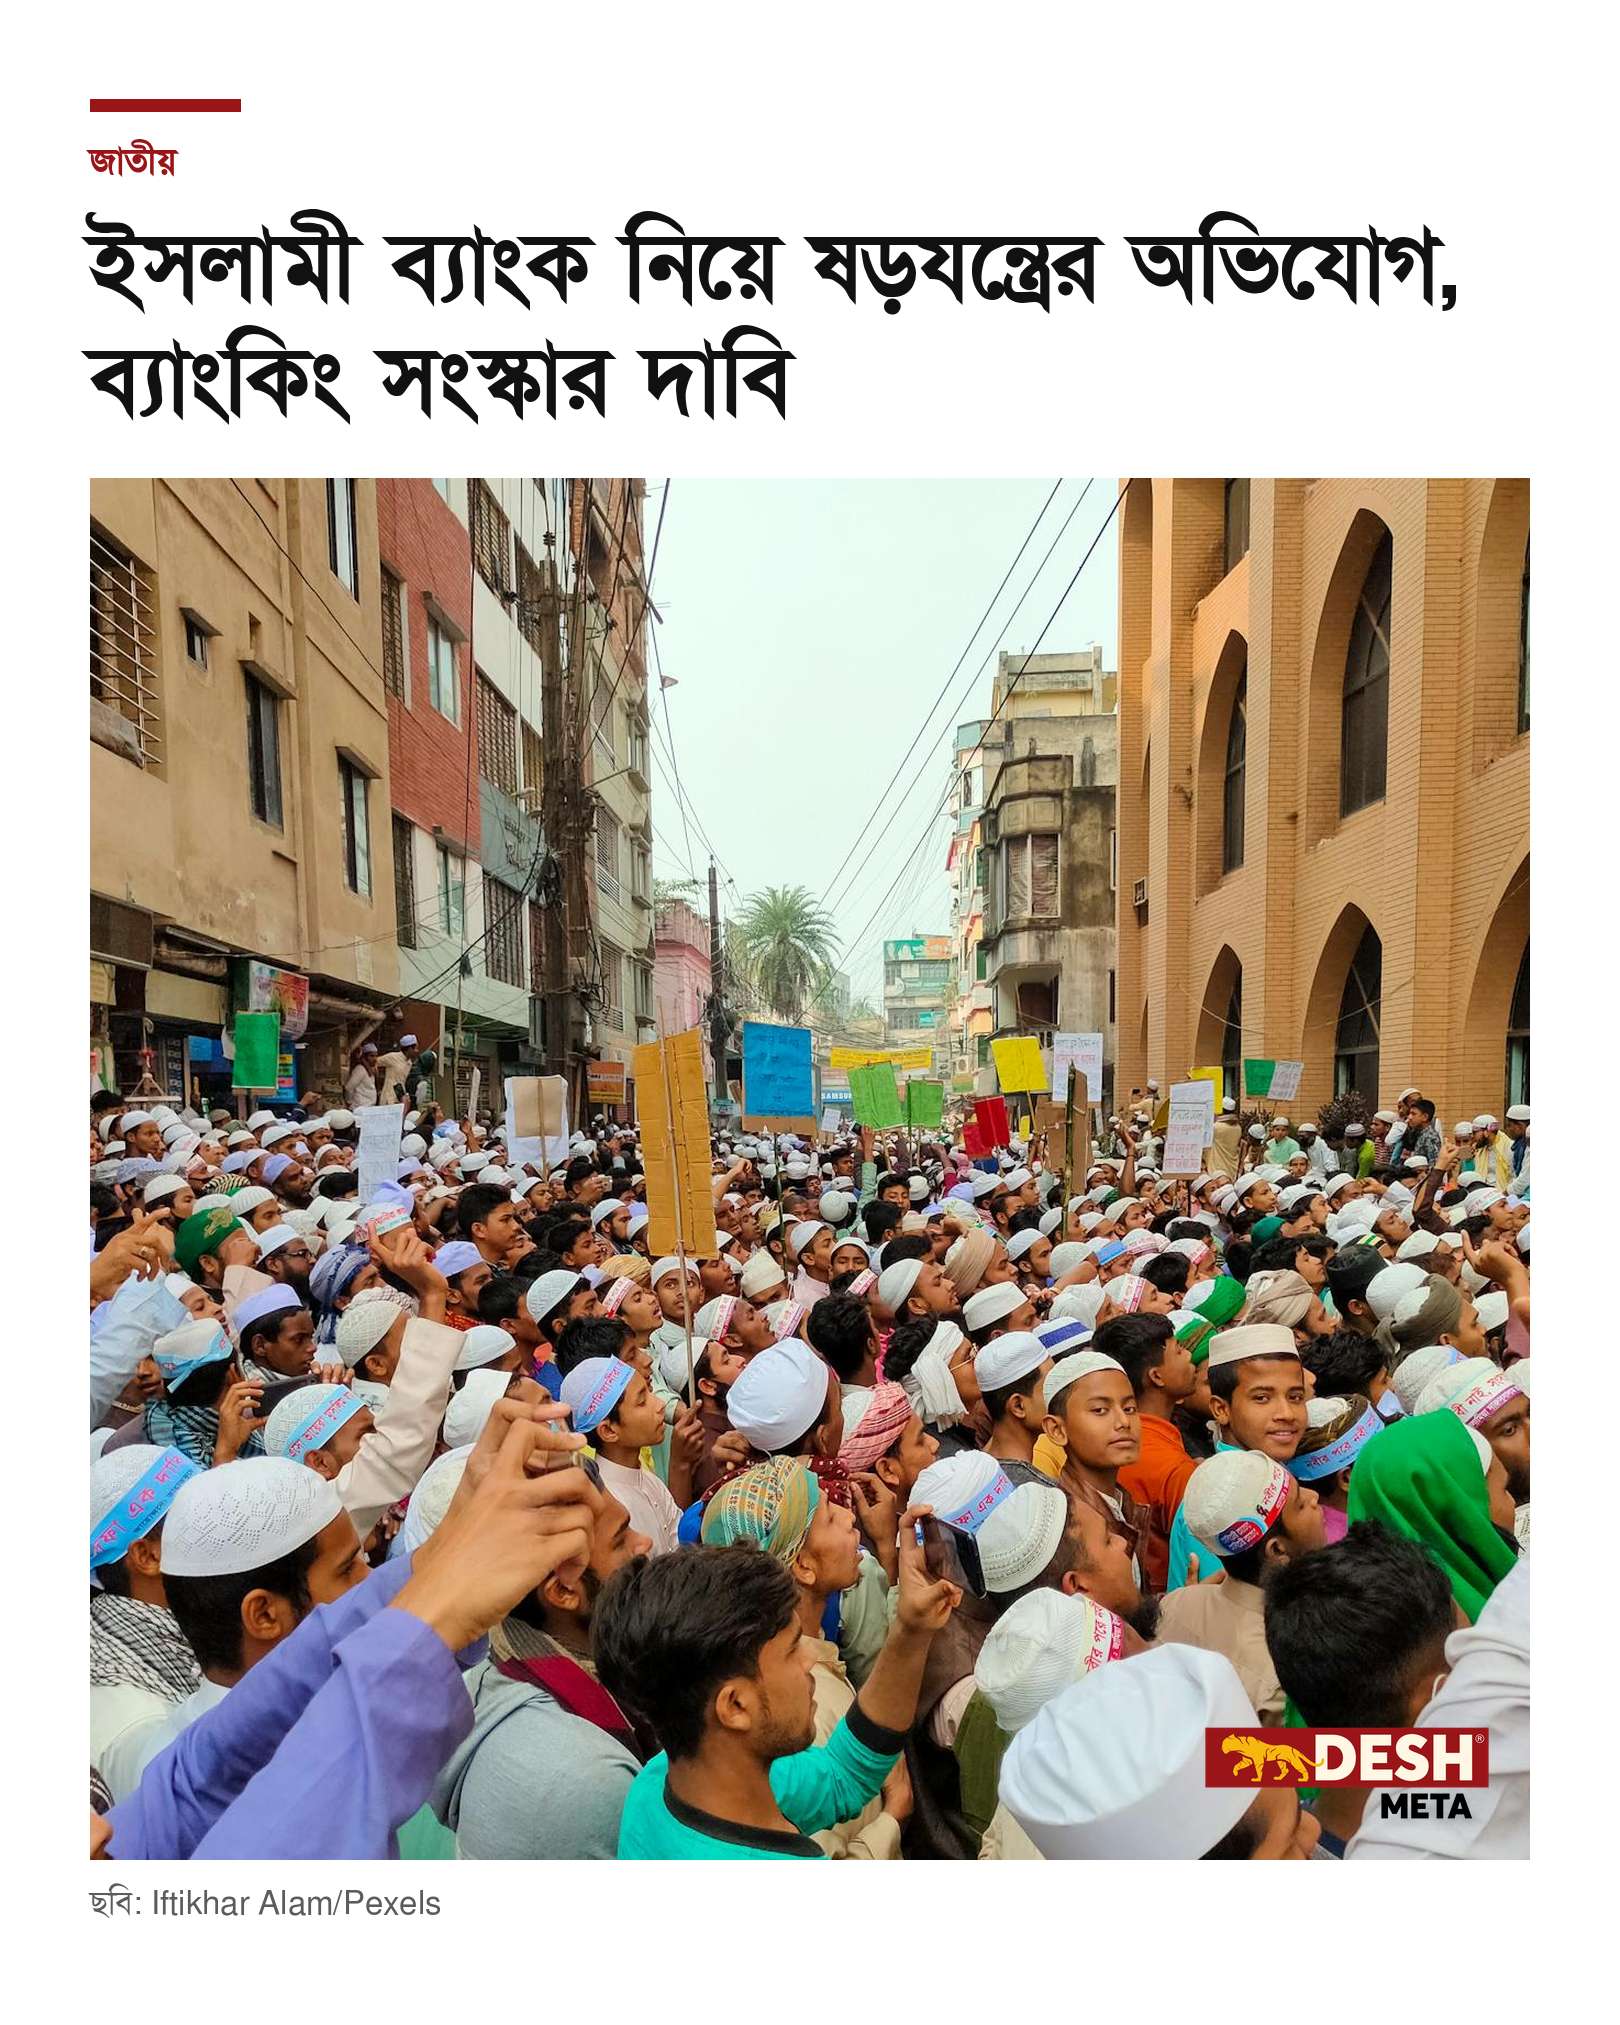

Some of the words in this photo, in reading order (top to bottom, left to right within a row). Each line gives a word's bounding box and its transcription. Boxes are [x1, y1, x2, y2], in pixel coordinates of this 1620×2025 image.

[128, 1488, 155, 1519] এক
[977, 1493, 994, 1513] এক
[1084, 1645, 1104, 1674] বীর
